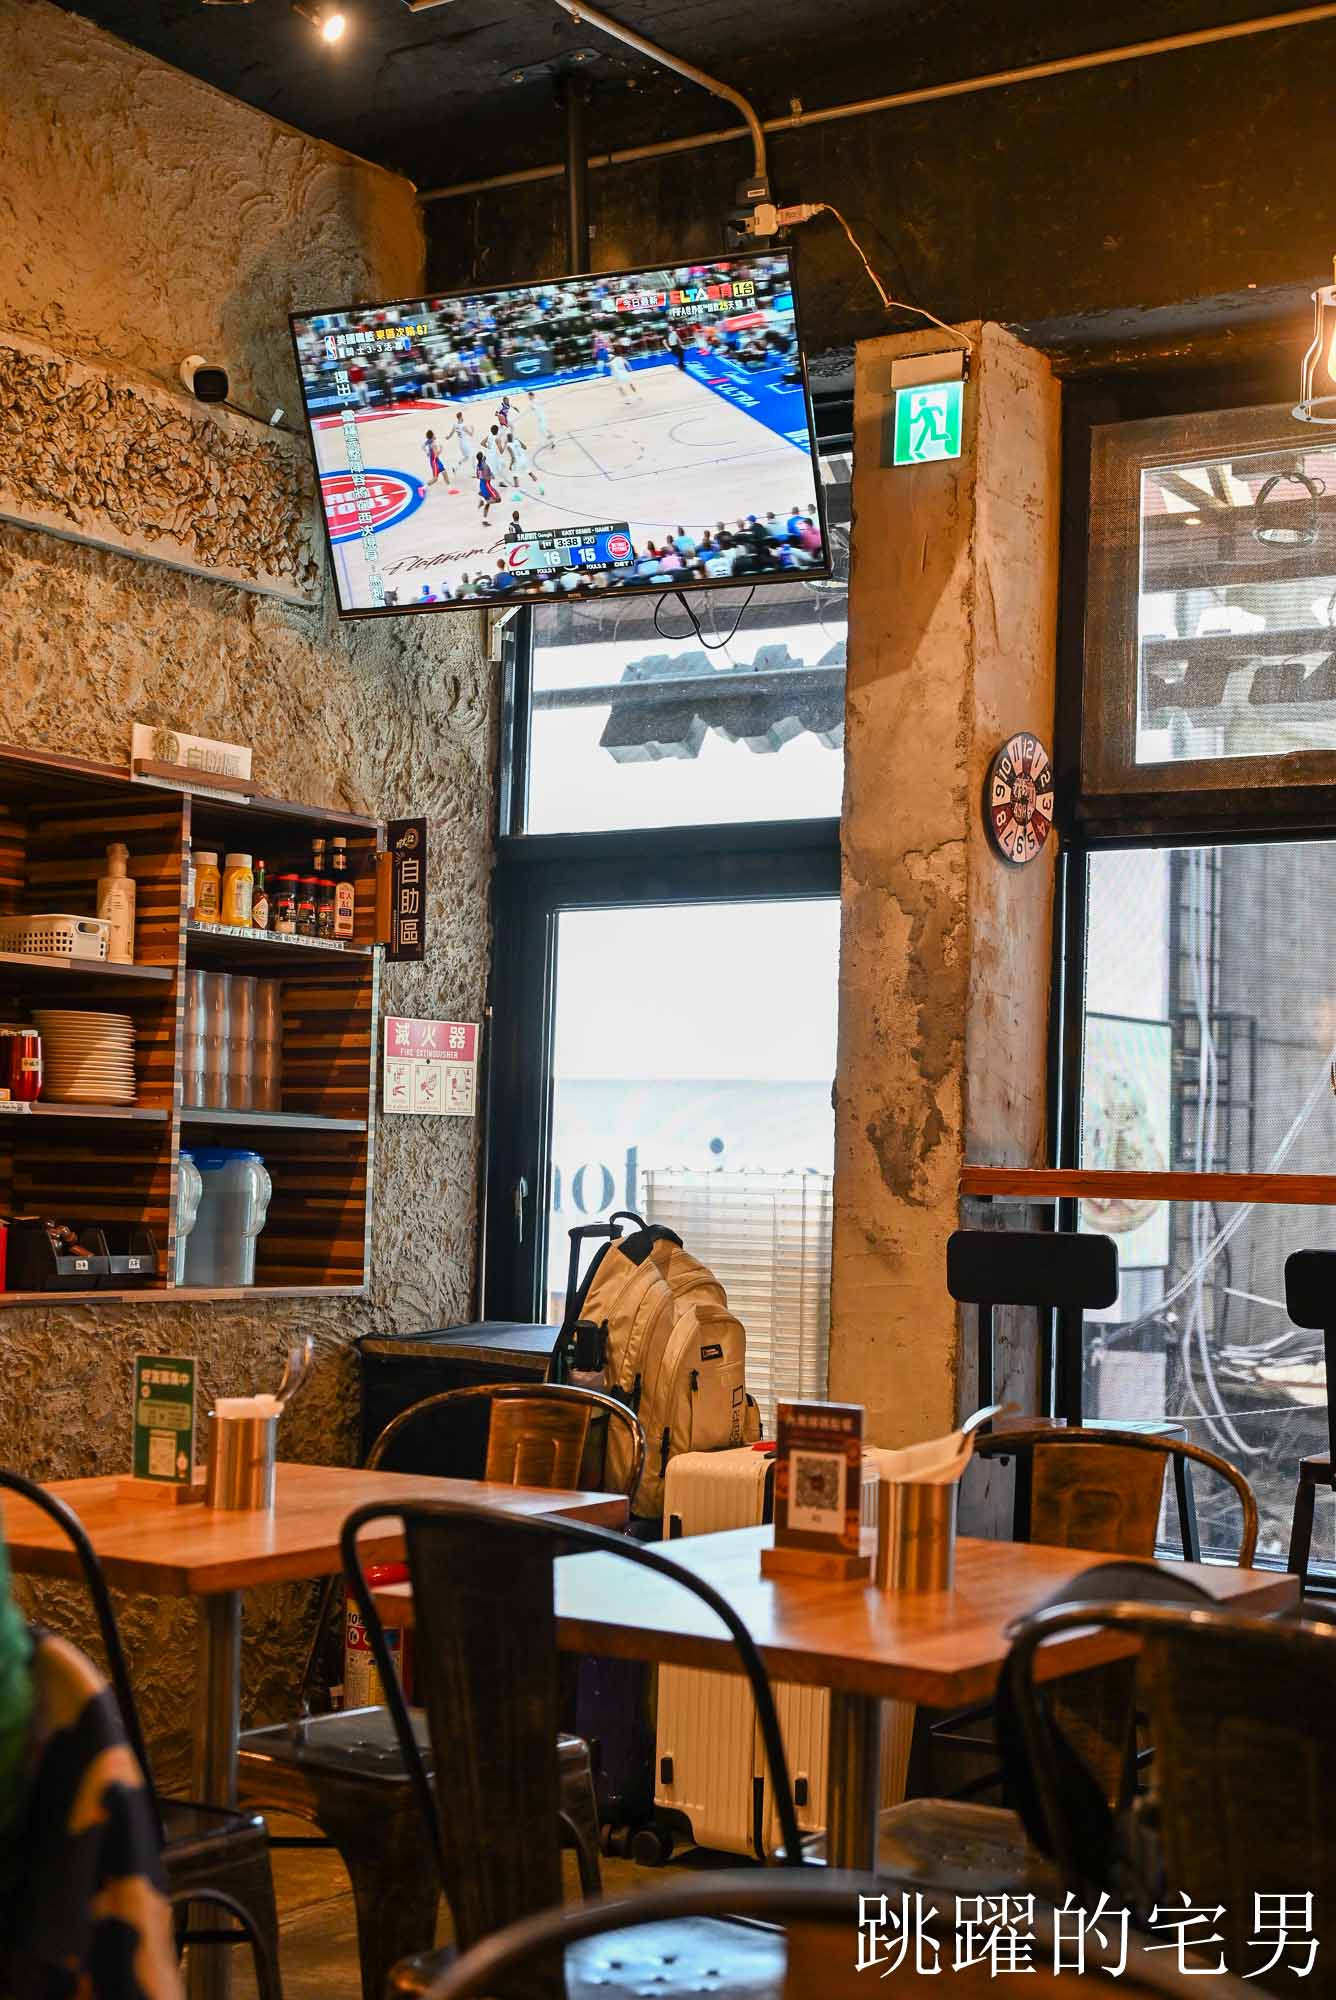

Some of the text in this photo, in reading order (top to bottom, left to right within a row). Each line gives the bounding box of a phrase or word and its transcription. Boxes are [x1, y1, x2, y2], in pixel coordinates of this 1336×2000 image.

[558, 538, 578, 547] 3:38
[544, 552, 561, 565] 16
[578, 548, 596, 562] 15
[1022, 738, 1034, 759] 12
[998, 758, 1012, 782] 10
[1040, 772, 1051, 788] 2
[996, 784, 1006, 798] 9
[1043, 799, 1051, 810] 3
[996, 810, 1006, 826] 8
[1004, 831, 1014, 846] 7
[1016, 836, 1024, 854] 6
[1027, 831, 1035, 850] 5
[400, 856, 420, 944] 自助區
[395, 1022, 466, 1049] 滅火器
[400, 1048, 458, 1058] FIRE EXTINGUISHER
